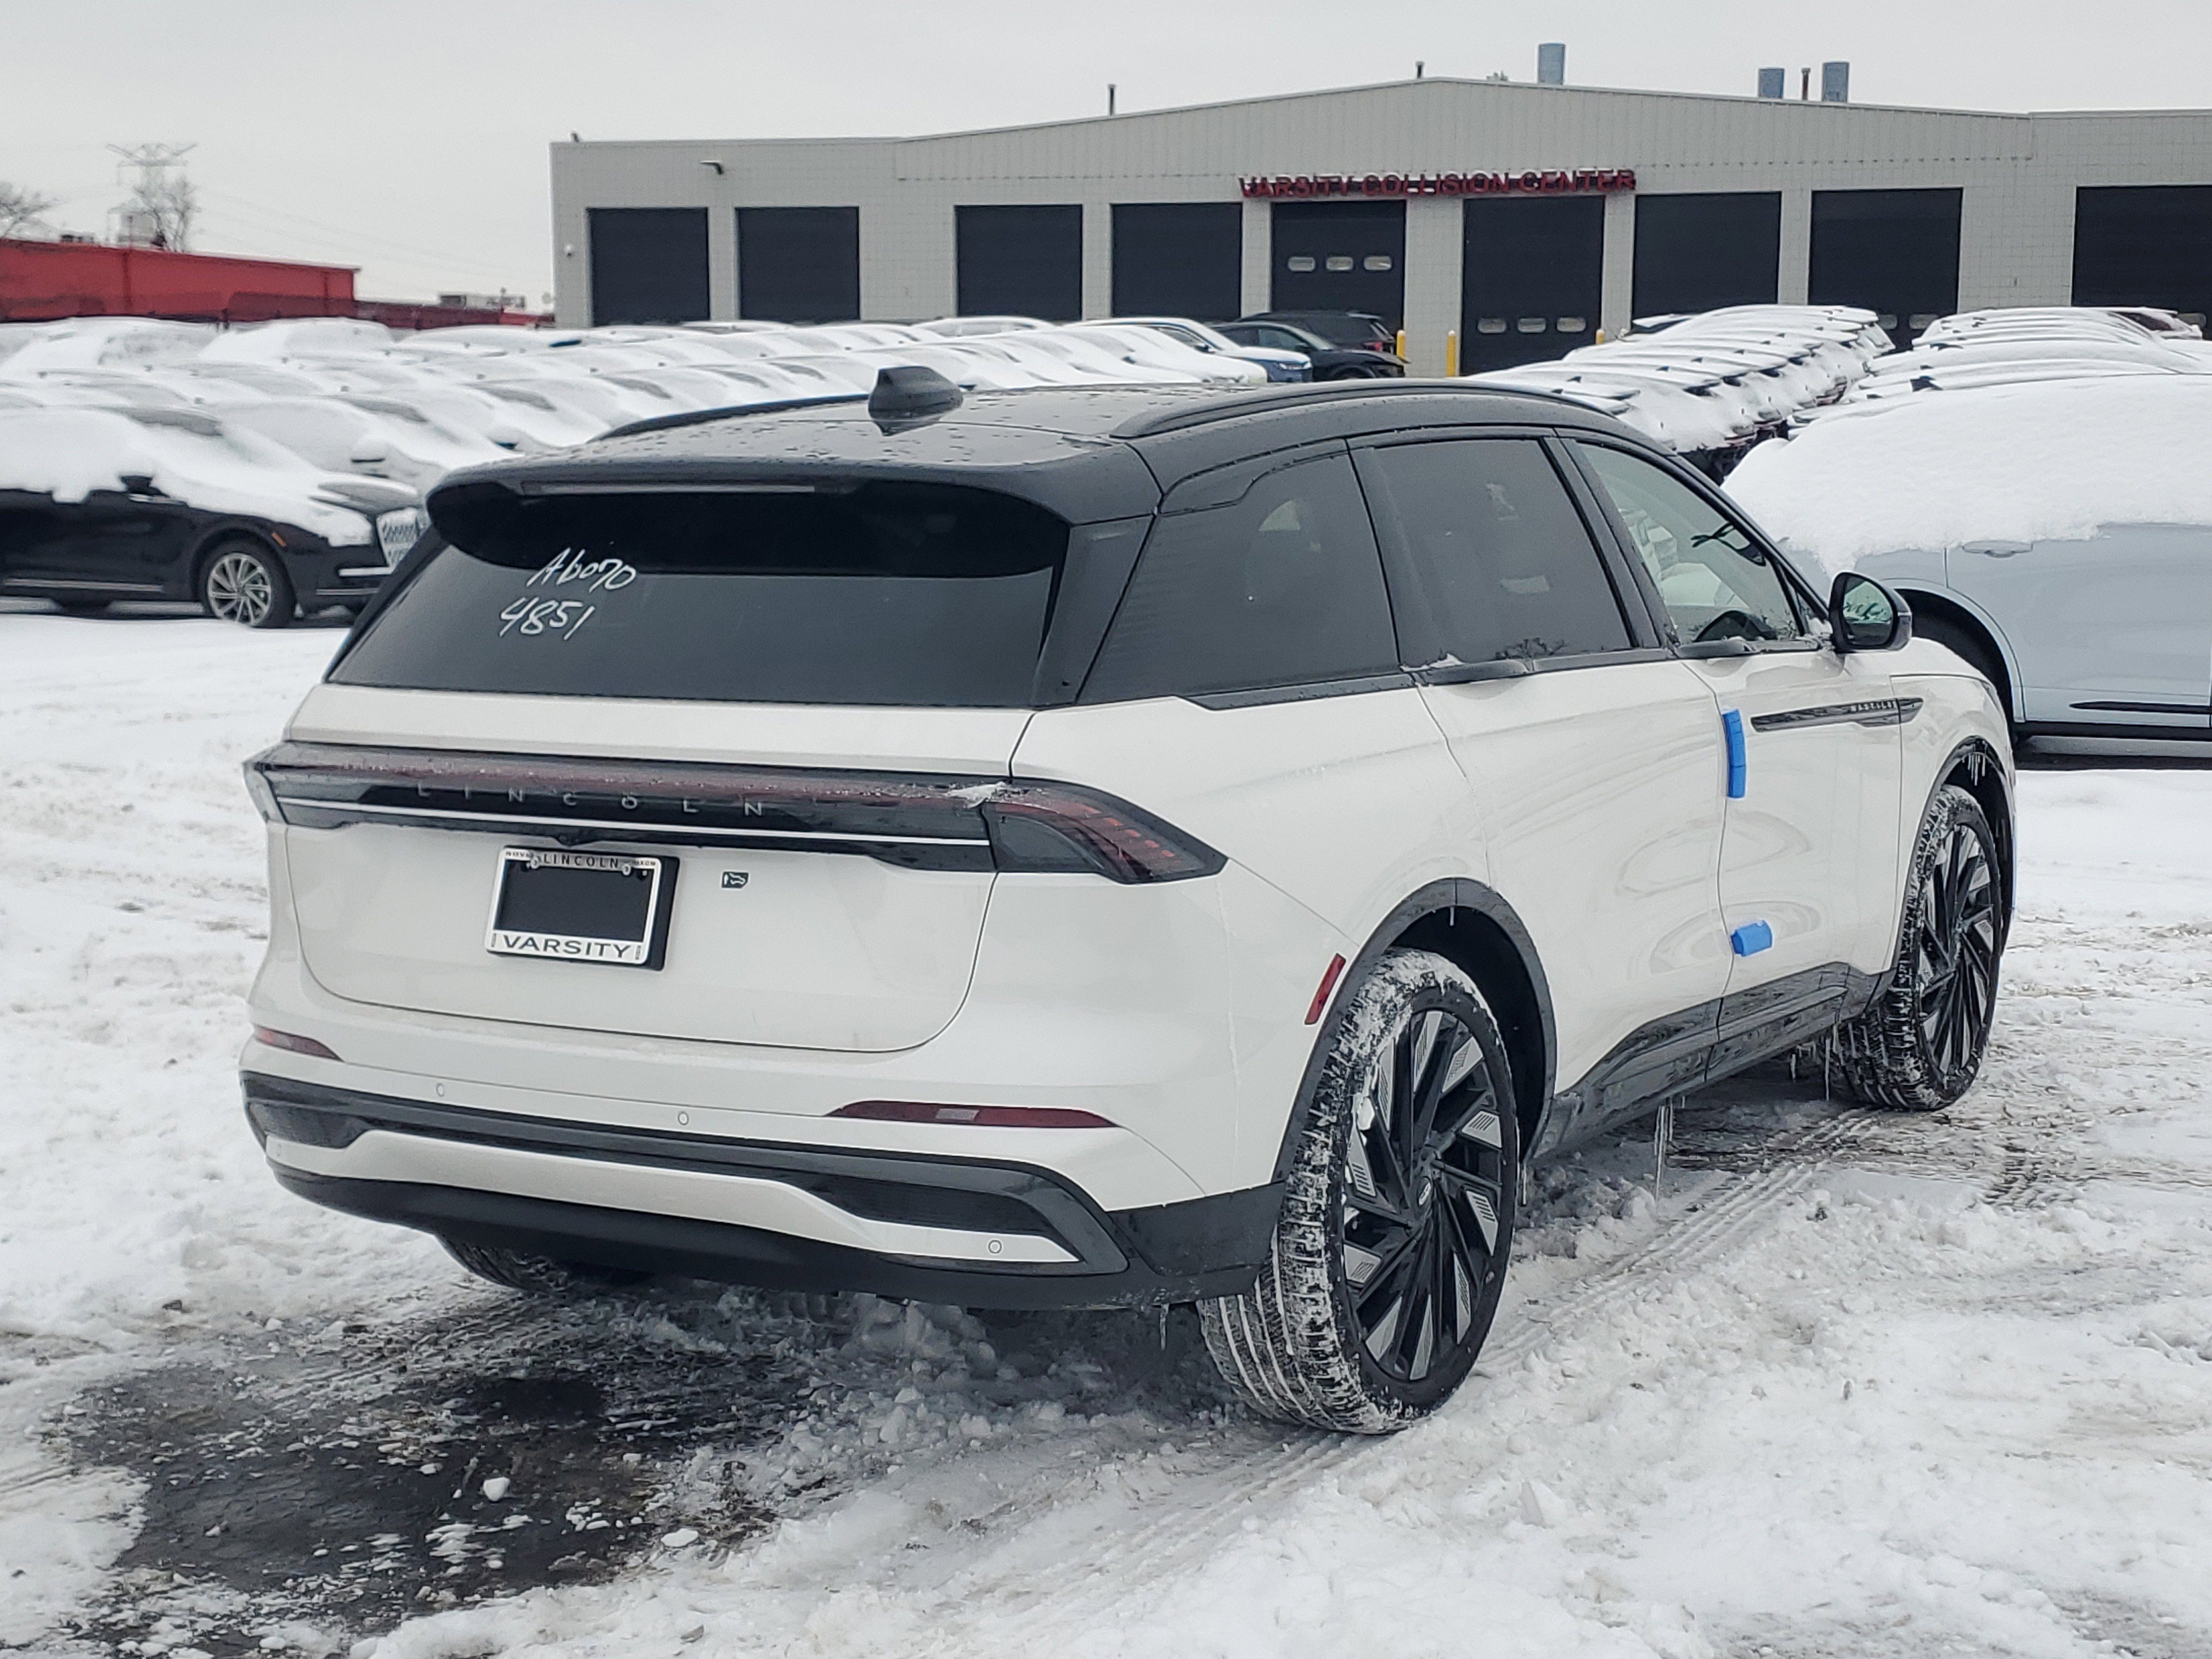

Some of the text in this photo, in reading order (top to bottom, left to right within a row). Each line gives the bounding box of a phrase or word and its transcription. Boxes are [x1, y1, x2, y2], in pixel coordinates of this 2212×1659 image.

[1238, 169, 1637, 198] VARSITY COLLISION CENTER
[499, 596, 596, 641] 4851
[417, 781, 763, 816] LINCOLN
[544, 853, 619, 868] LINCOLN
[503, 935, 631, 958] VARSITY
